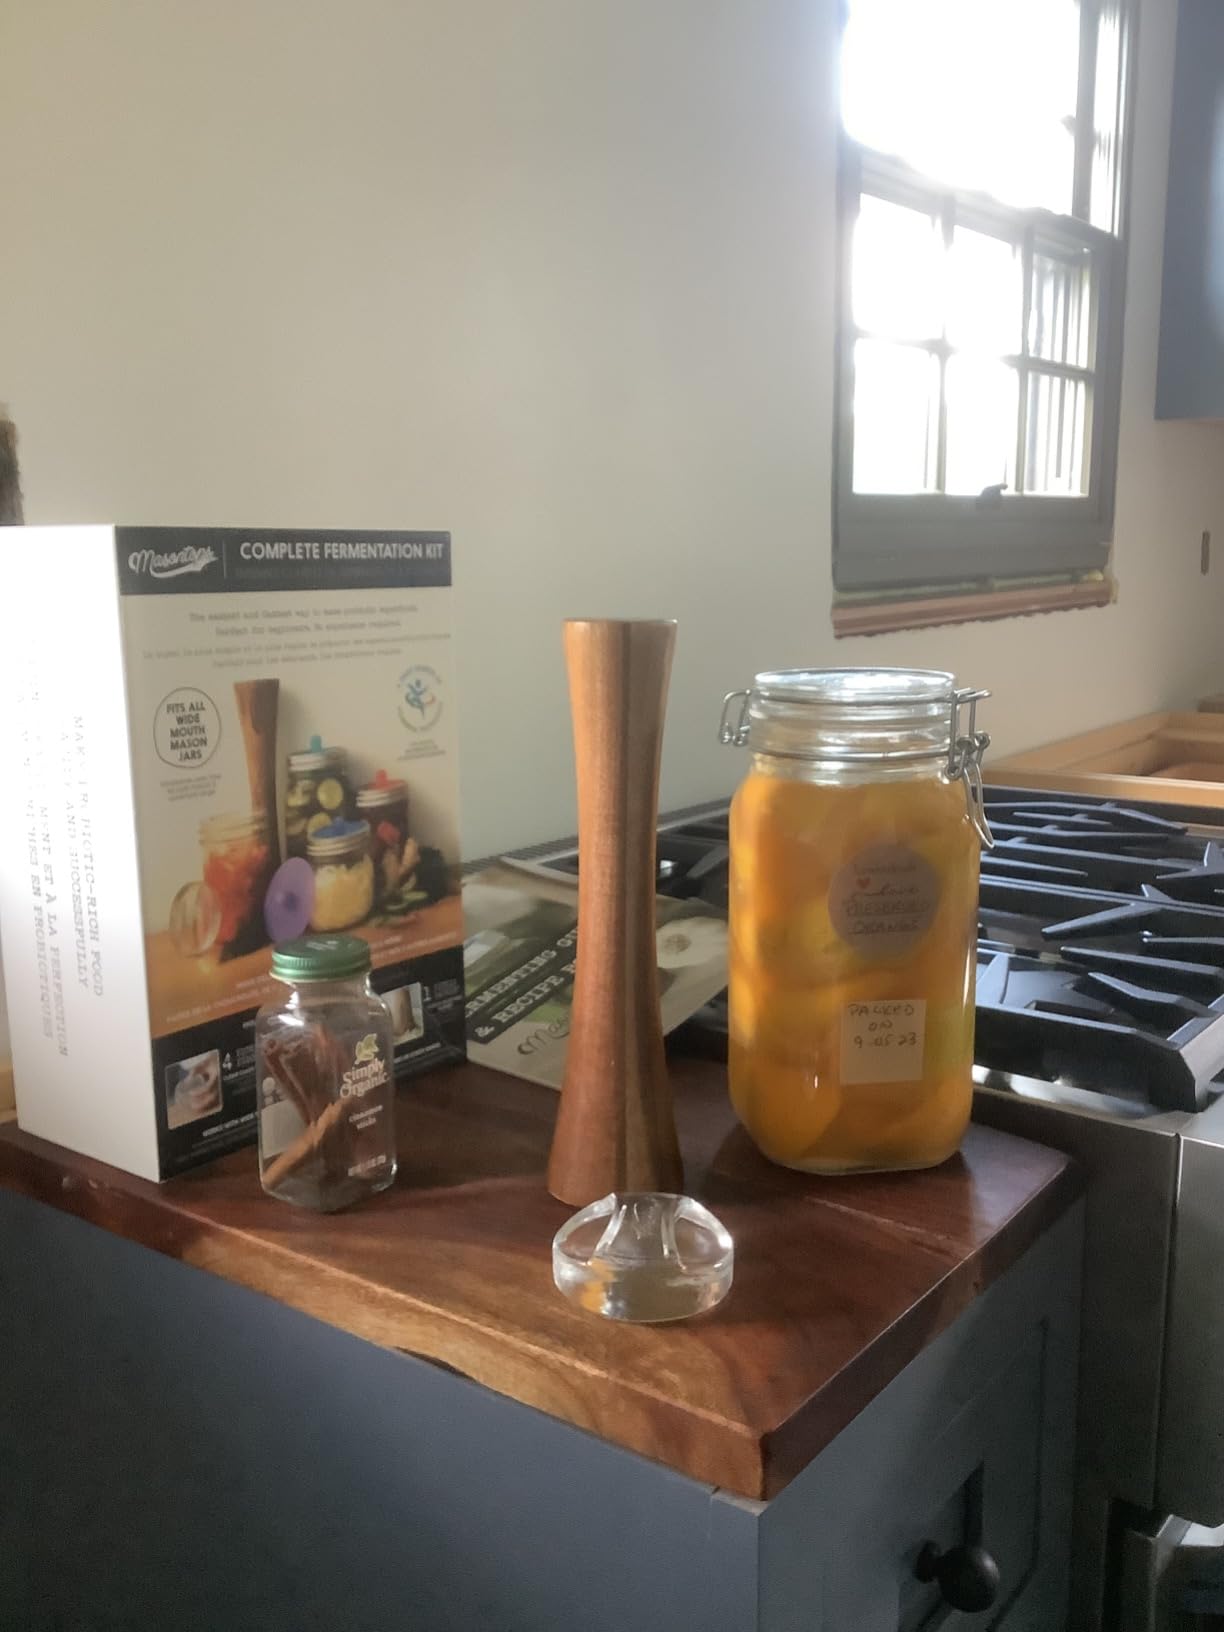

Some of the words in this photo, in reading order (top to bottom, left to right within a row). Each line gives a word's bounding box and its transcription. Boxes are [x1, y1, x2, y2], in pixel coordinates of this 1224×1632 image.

[239, 542, 320, 560] COMPLETE
[324, 543, 422, 559] FERMENTATION
[425, 543, 444, 559] KIT
[166, 703, 185, 714] FITS
[189, 701, 205, 712] ALL
[176, 713, 200, 725] WIDE
[169, 725, 206, 739] MOUTH
[170, 737, 207, 751] MASON
[179, 749, 202, 761] JARS
[465, 949, 557, 1018] RMENTING
[491, 975, 564, 1023] RECIPE
[342, 1057, 385, 1083] Simply
[340, 1071, 390, 1098] Organic
